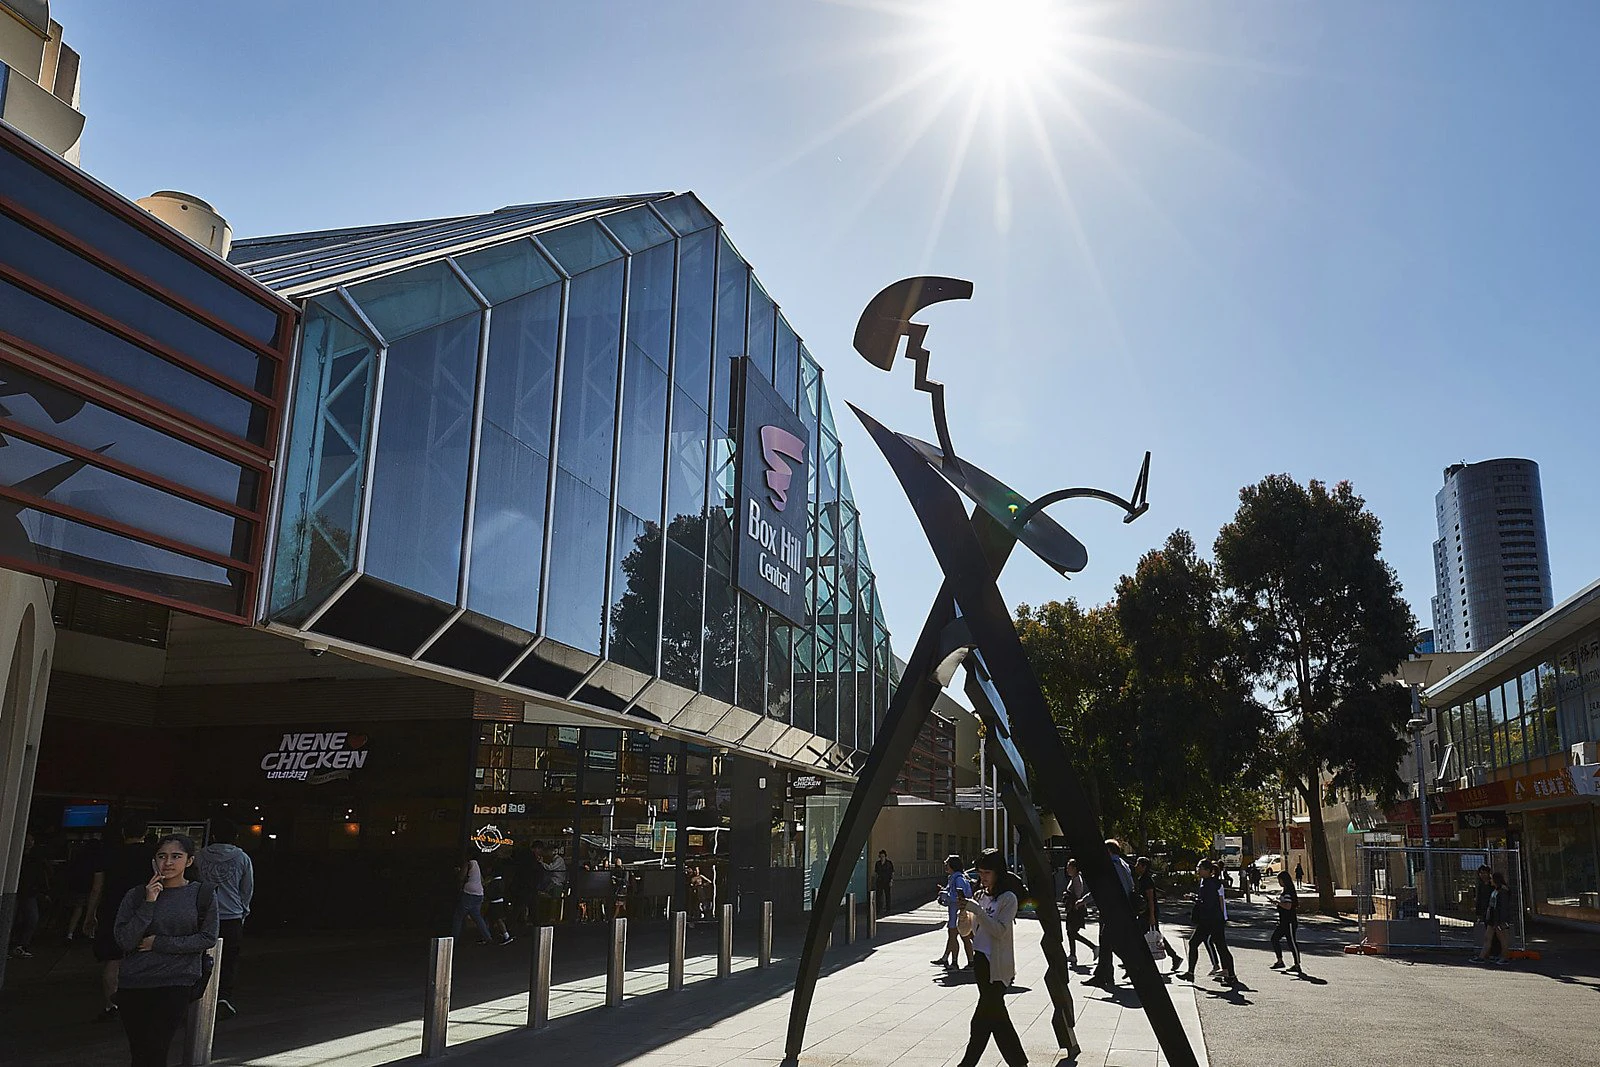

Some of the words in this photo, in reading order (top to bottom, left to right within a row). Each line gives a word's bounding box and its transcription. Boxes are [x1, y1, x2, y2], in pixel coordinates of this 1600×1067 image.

[748, 498, 777, 556] Box
[780, 526, 802, 575] Hill
[759, 552, 790, 596] Central
[279, 732, 348, 751] NENE
[260, 750, 369, 771] CHICKEN
[266, 770, 309, 781] 네네치킨
